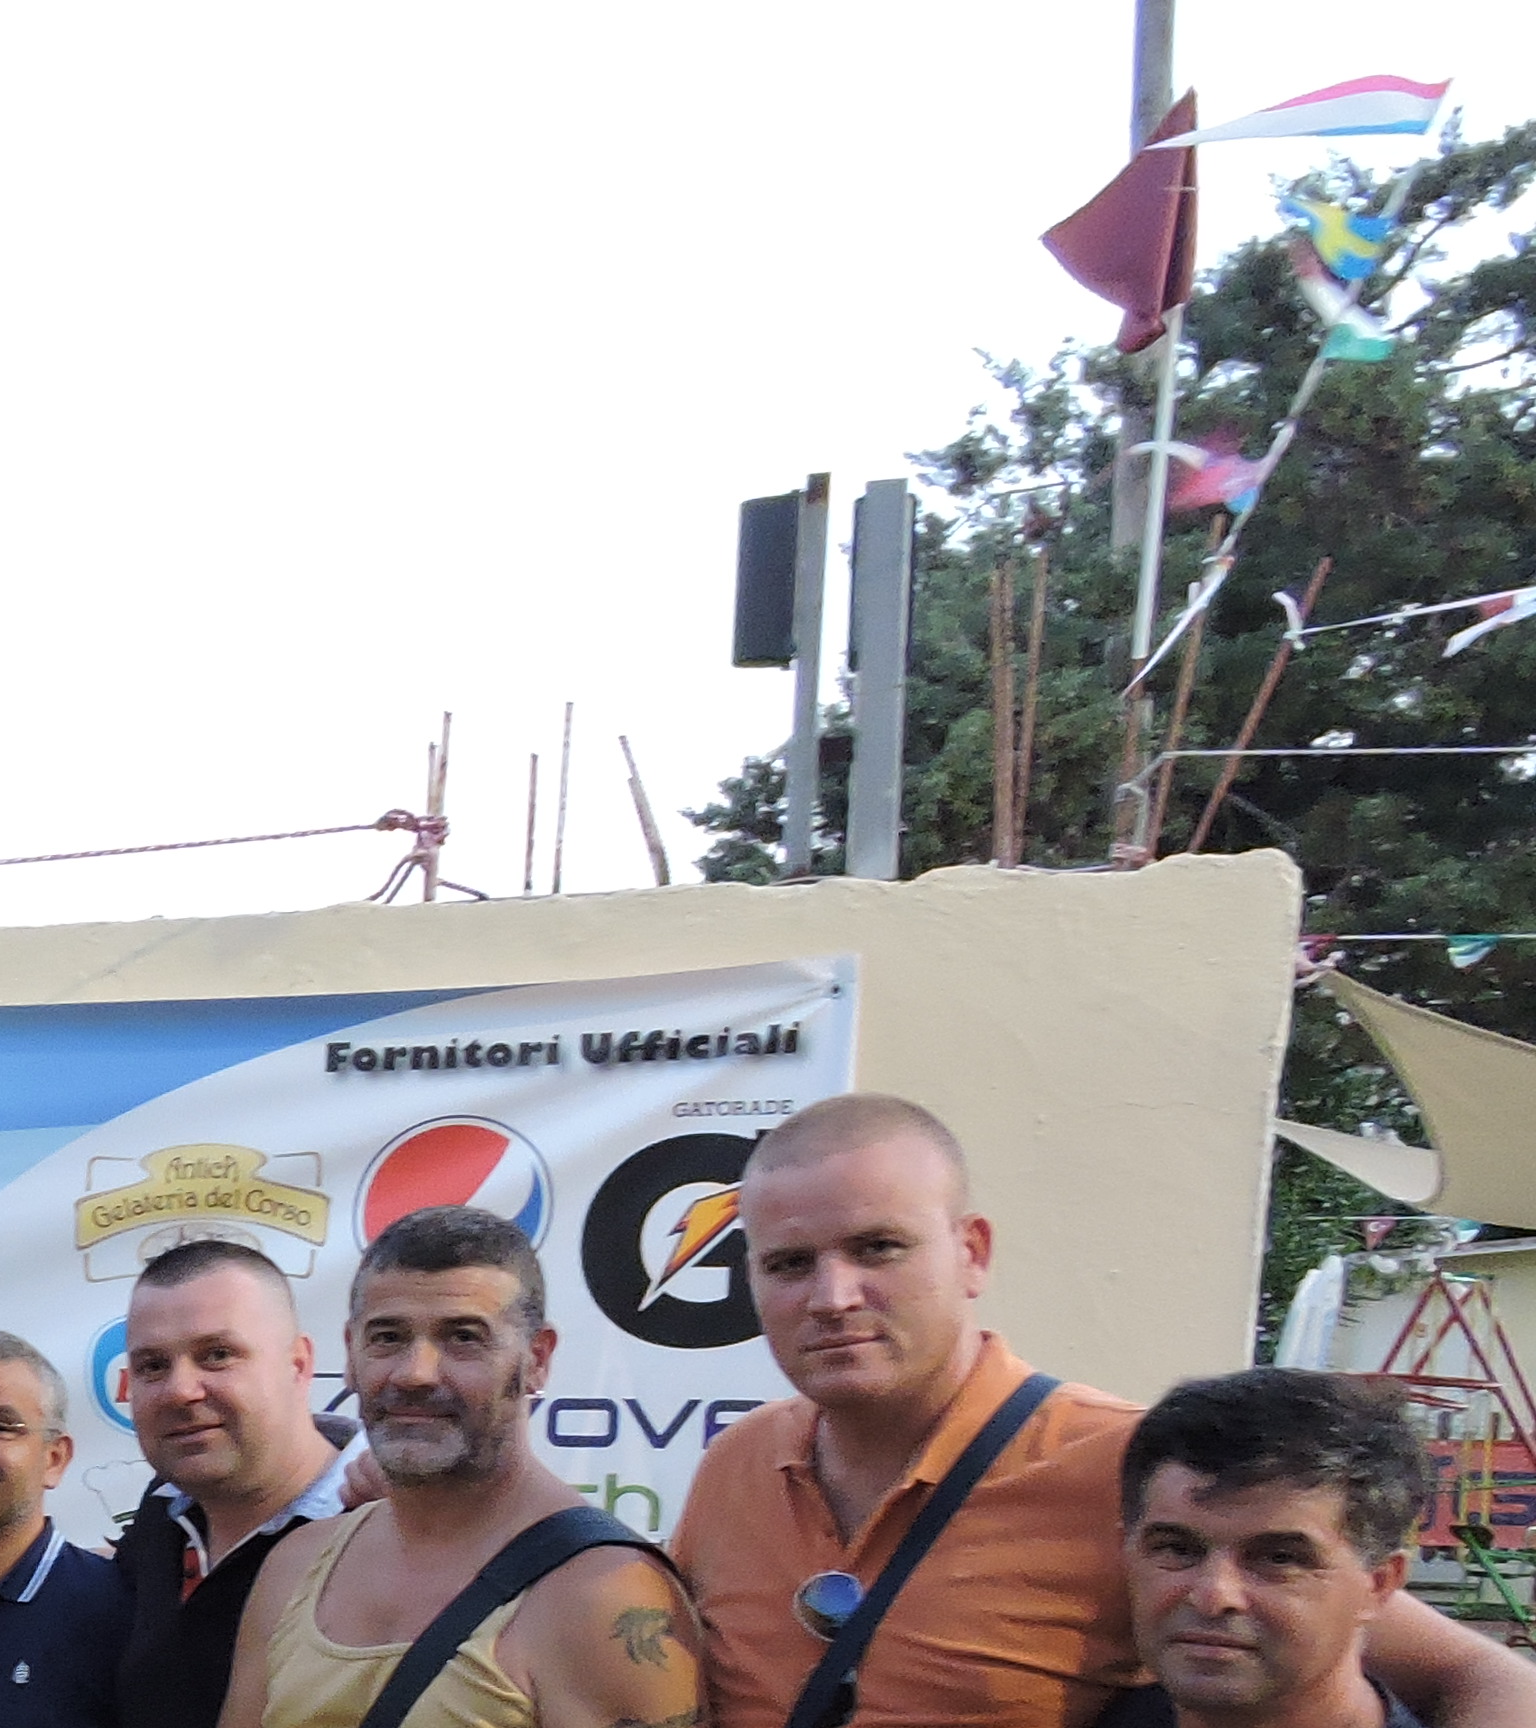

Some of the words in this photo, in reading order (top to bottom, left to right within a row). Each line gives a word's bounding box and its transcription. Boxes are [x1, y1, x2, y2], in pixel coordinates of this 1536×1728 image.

[325, 1034, 561, 1074] Fornitori
[581, 1022, 802, 1065] Ufficiali
[672, 1099, 795, 1118] GATORADE
[91, 1187, 198, 1228] Gelateria
[206, 1185, 241, 1209] del
[245, 1188, 312, 1227] Corso
